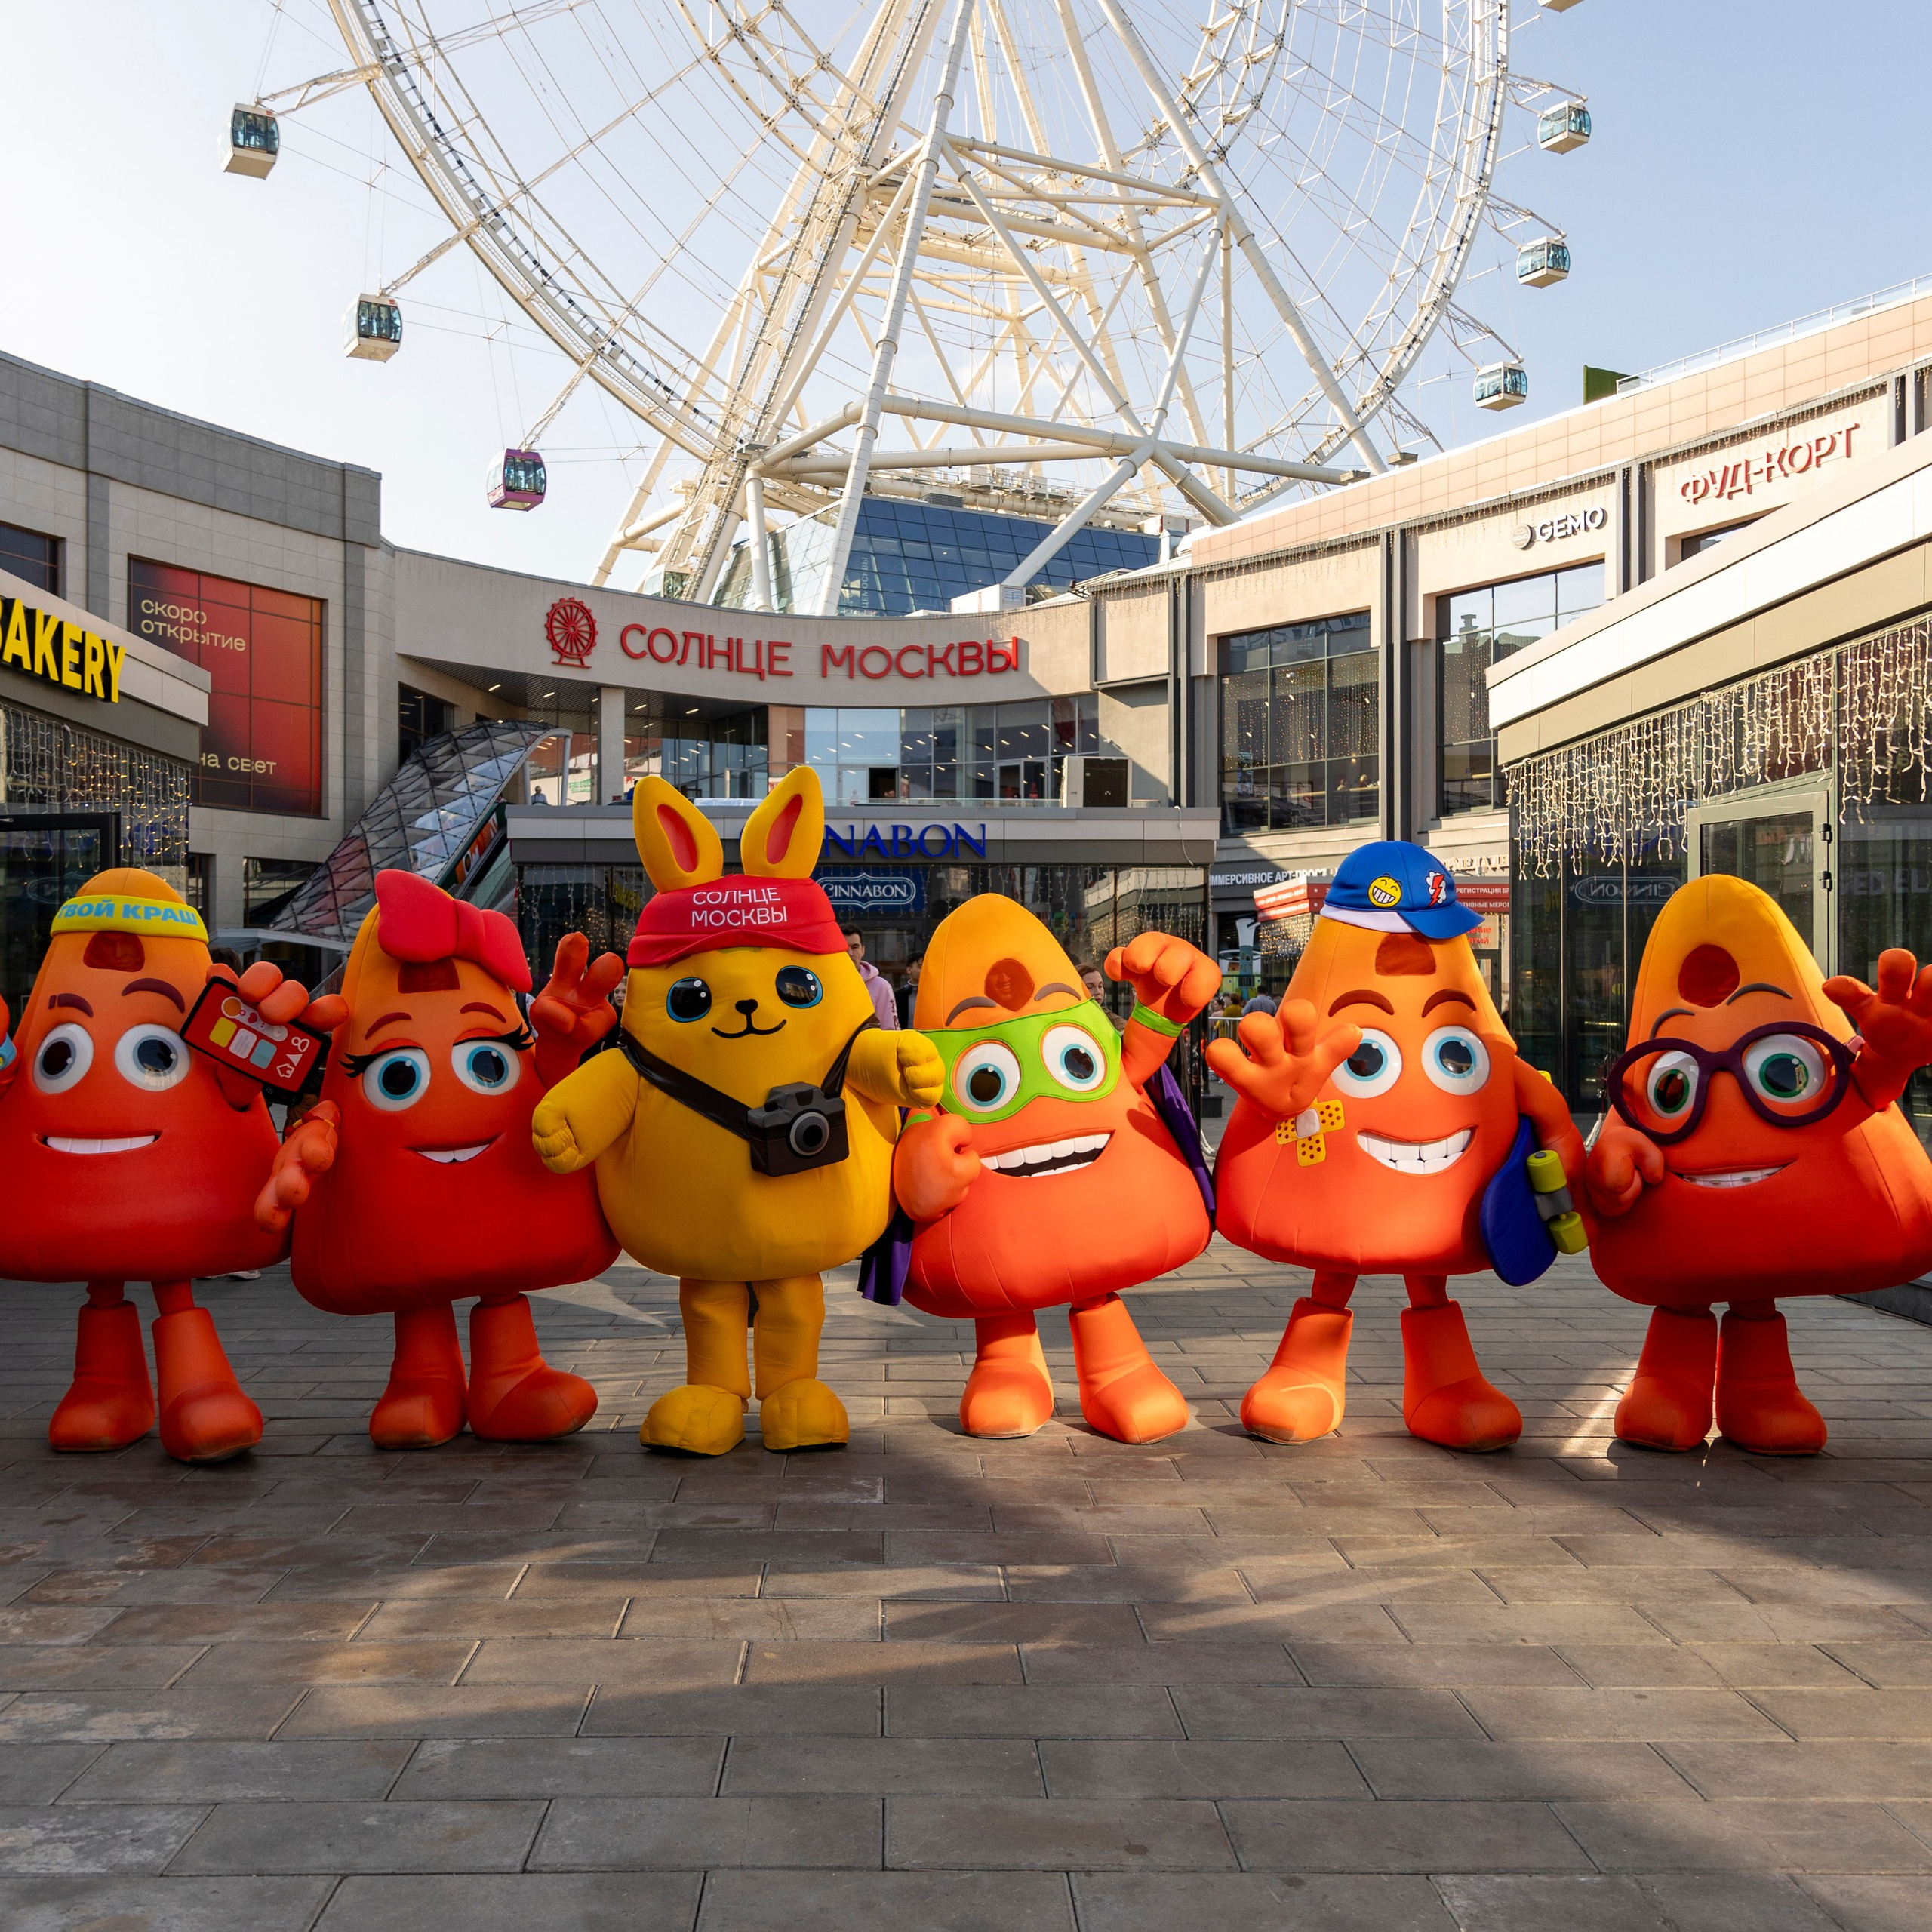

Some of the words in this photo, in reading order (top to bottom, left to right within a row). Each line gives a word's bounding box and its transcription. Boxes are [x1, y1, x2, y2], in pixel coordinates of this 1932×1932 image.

[1680, 423, 1860, 505] ФУД-КОРТ
[1535, 506, 1604, 541] GEMO
[141, 599, 208, 624] скоро
[141, 619, 246, 651] открытие
[0, 595, 126, 703] AKERY
[620, 623, 794, 681] СОЛНЦЕ
[821, 636, 1018, 679] МОСКВЫ
[227, 756, 277, 774] свет
[823, 823, 986, 859] NABON
[821, 882, 908, 898] CINNABON
[1211, 872, 1274, 886] ММЕРСИВНОЕ
[692, 887, 781, 905] СОЛНЦЕ
[58, 899, 115, 918] ТВОЙ
[121, 904, 198, 926] КРАШ
[691, 906, 788, 928] МОСКВЫ
